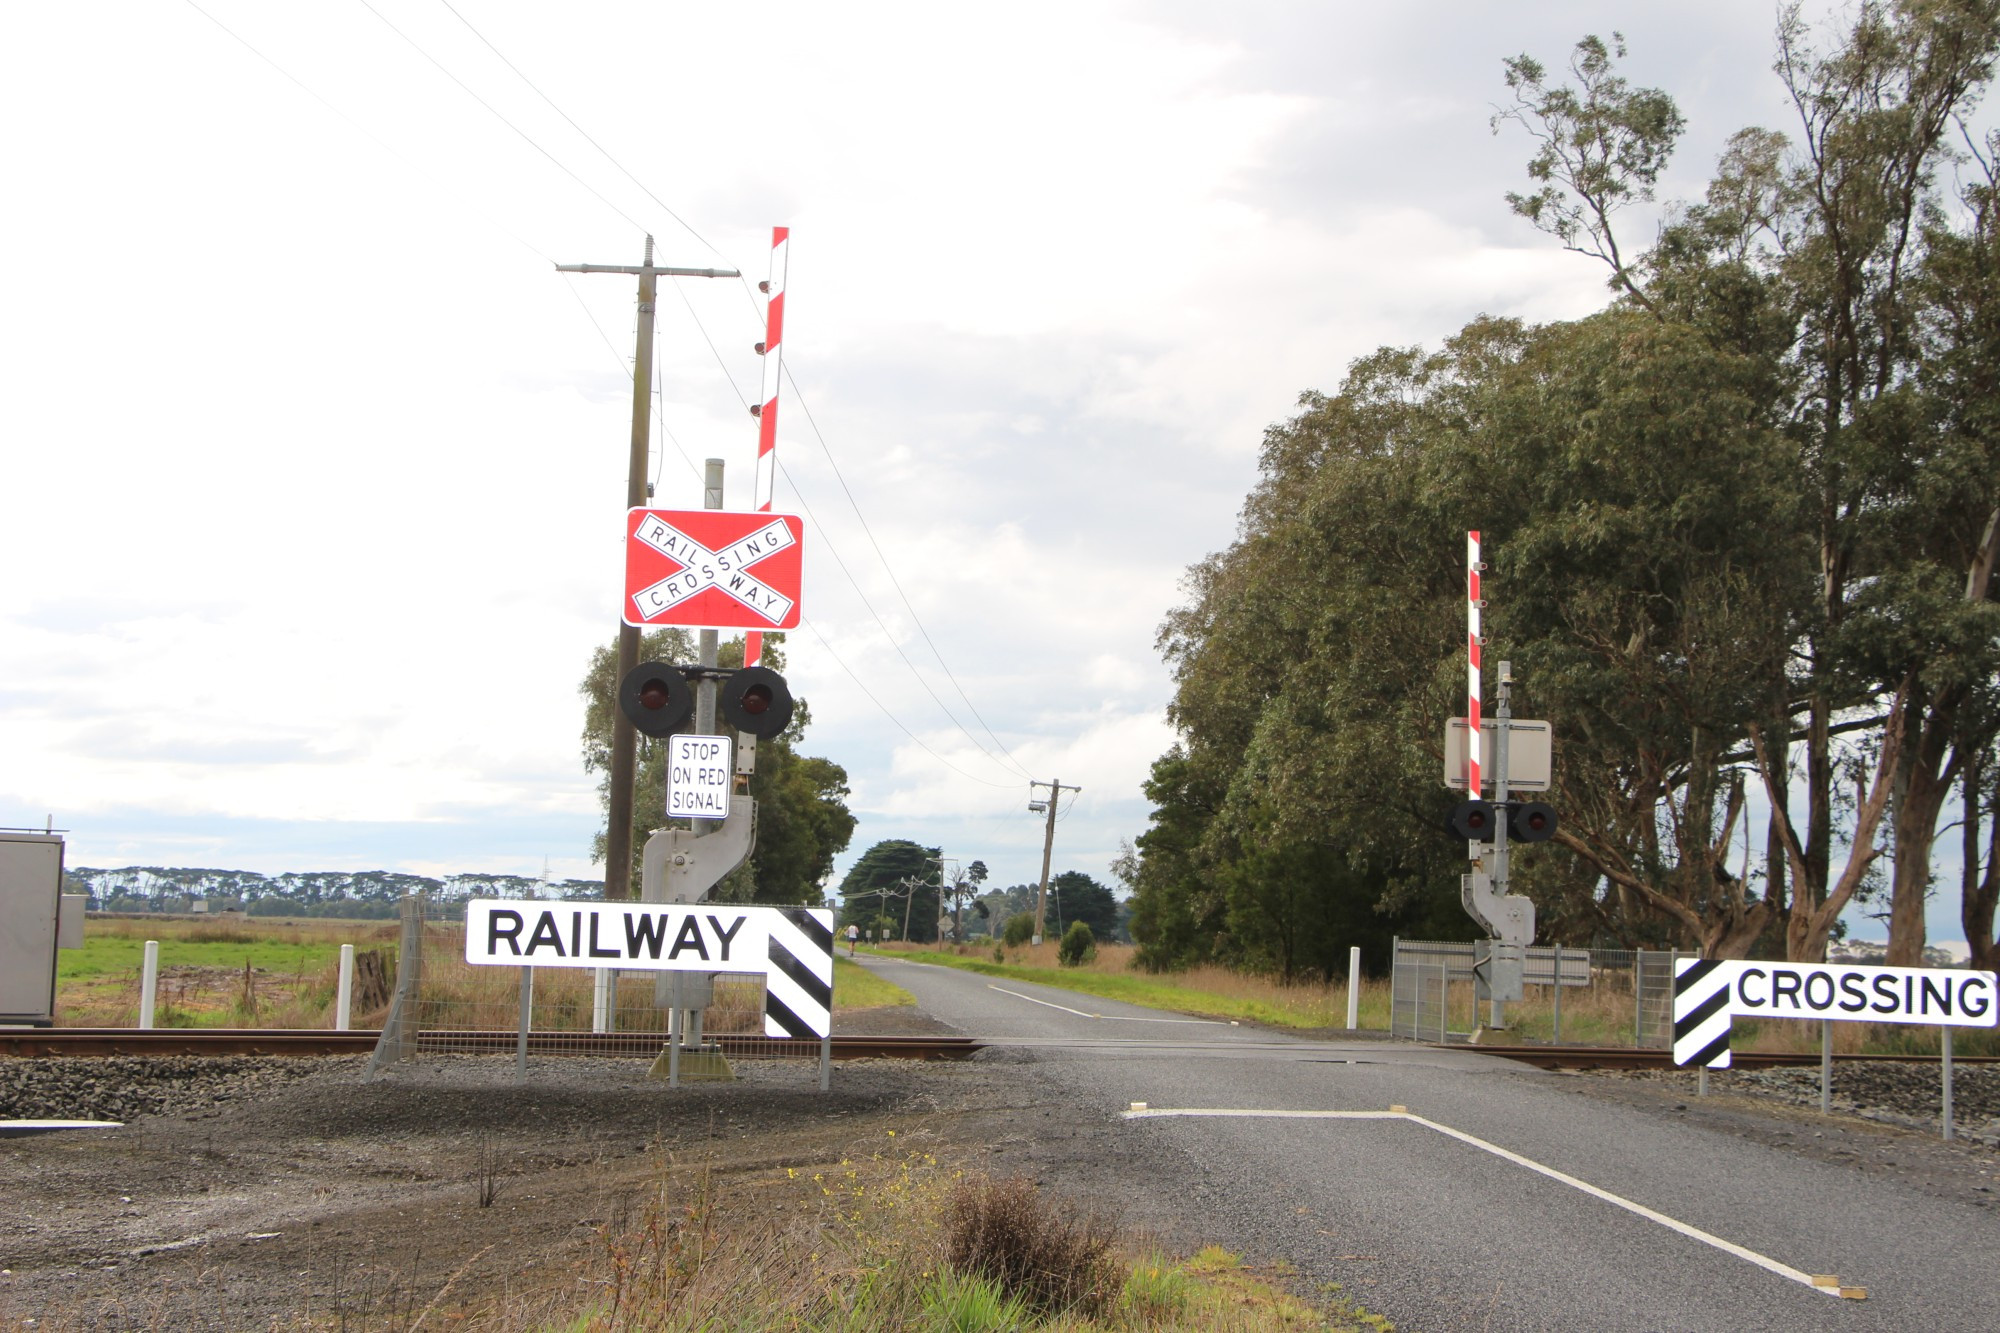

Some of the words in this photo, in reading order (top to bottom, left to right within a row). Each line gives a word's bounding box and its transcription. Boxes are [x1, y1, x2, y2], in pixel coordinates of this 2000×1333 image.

[651, 532, 778, 606] CROSSING
[682, 743, 719, 760] STOP
[673, 767, 691, 784] ON
[699, 768, 725, 785] RED
[673, 791, 723, 810] SIGNAL
[487, 909, 747, 961] RAILWAY
[1737, 968, 1989, 1018] CROSSING
